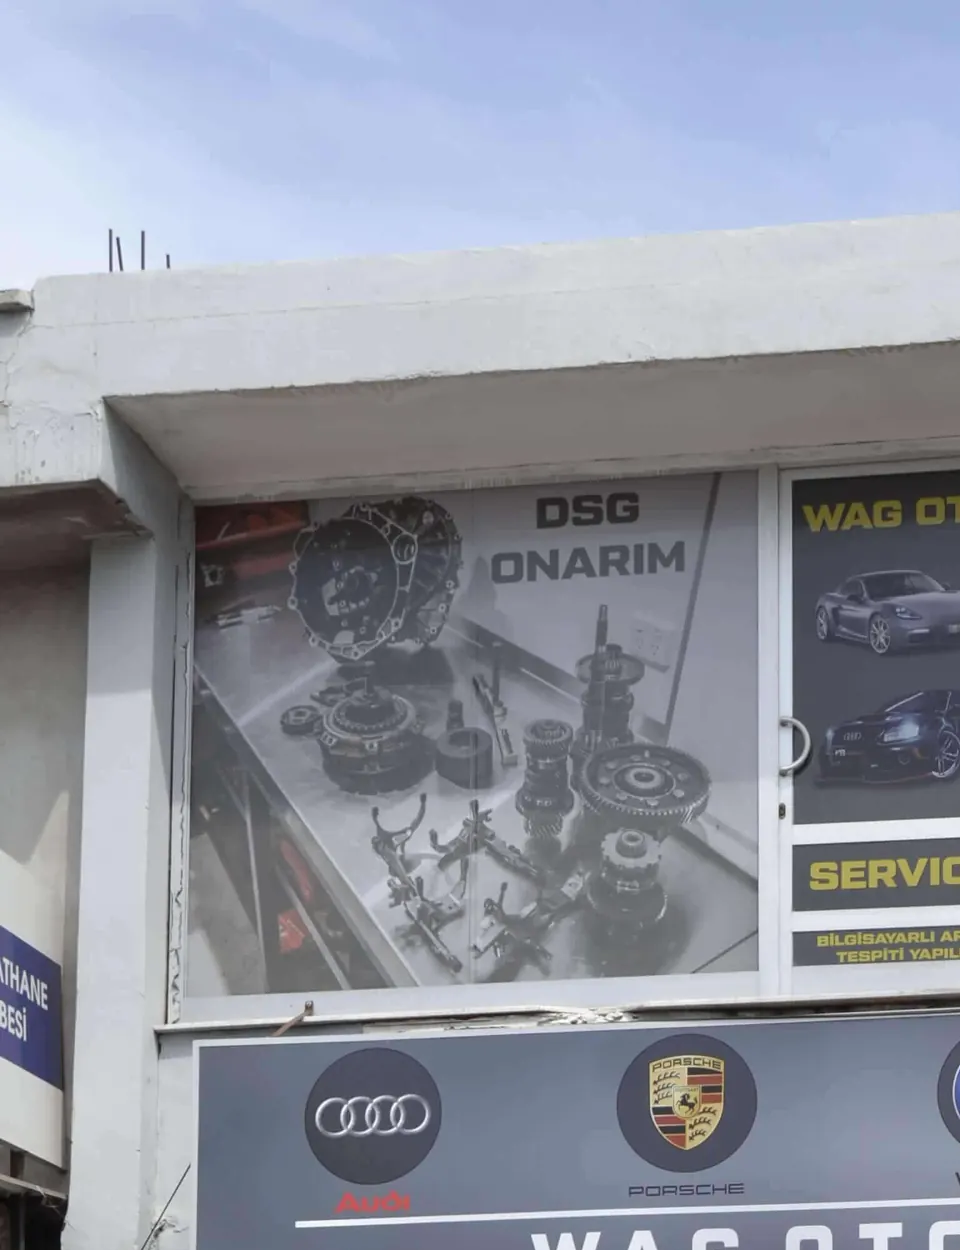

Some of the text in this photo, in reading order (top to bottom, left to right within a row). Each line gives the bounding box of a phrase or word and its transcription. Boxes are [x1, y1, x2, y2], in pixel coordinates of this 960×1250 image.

[535, 493, 640, 529] DSG
[803, 499, 902, 532] WAG
[490, 540, 685, 584] ONARIM
[816, 931, 936, 947] BİLGİSAYARLI
[836, 946, 905, 963] TESPİTİ
[652, 1057, 722, 1073] PORSCHE
[628, 1182, 745, 1197] PORSCHE
[333, 1189, 411, 1214] Audi
